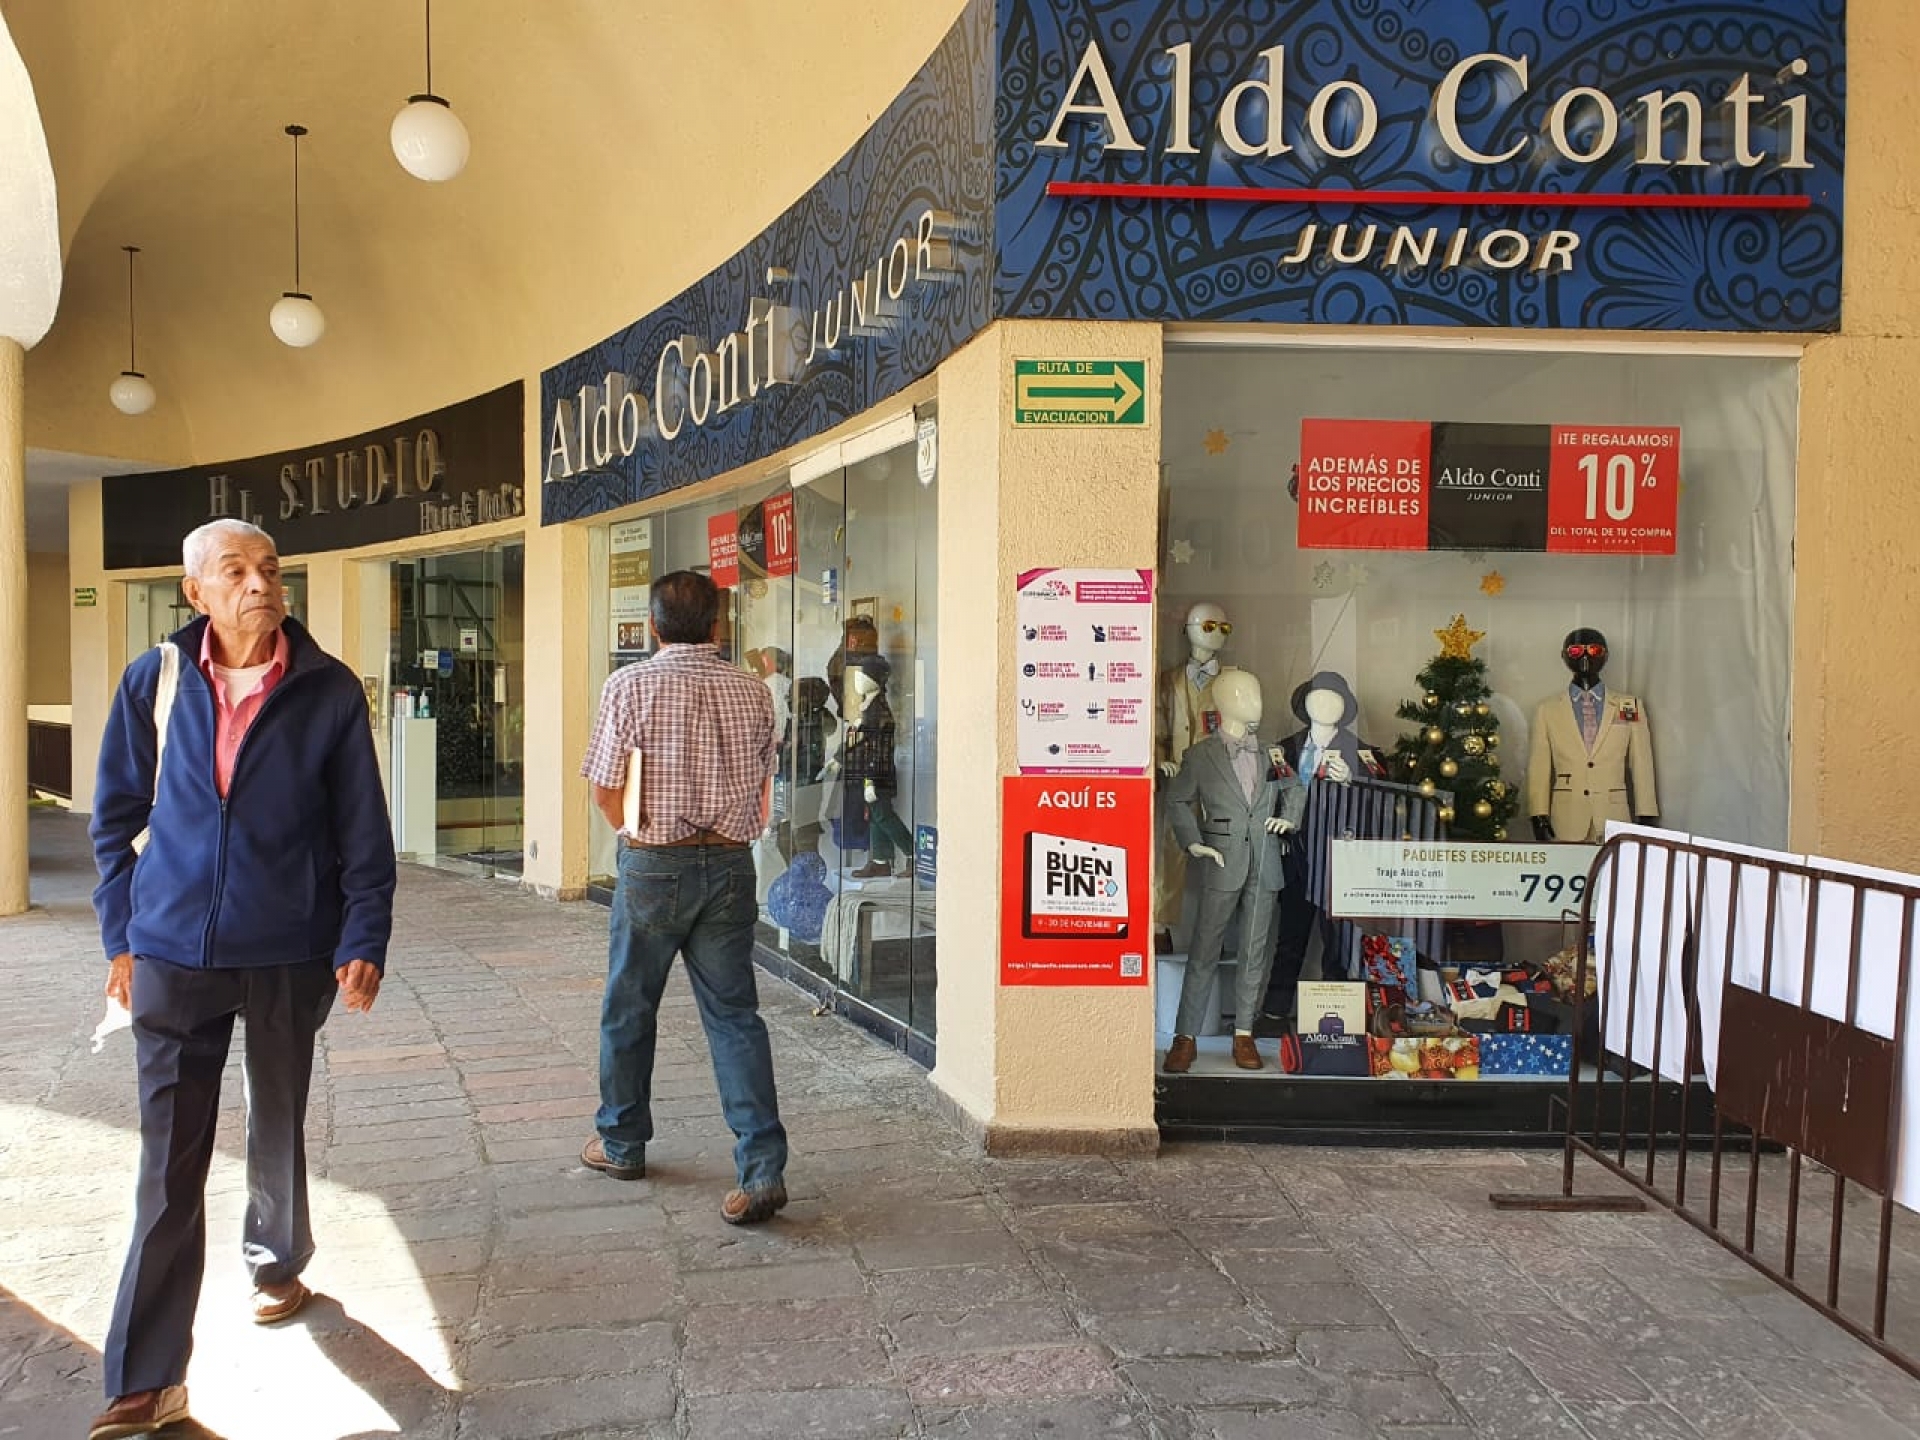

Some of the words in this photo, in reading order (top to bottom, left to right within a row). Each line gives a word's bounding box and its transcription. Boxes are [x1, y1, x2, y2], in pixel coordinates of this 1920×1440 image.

[1034, 39, 1379, 159] Aldo
[1434, 52, 1815, 171] Conti
[1282, 223, 1581, 272] JUNIOR
[805, 209, 938, 364] JUNIOR
[544, 373, 640, 484] Aldo
[655, 267, 780, 440] Conti
[1037, 362, 1070, 373] RUTA
[1076, 362, 1093, 373] DE
[1022, 411, 1108, 423] EVACUACION
[1582, 433, 1674, 447] REGALAMOS!
[279, 428, 438, 521] STUDIO
[1308, 453, 1389, 475] ADEMÁS
[1397, 459, 1421, 475] DE
[1308, 476, 1341, 492] LOS
[1346, 477, 1421, 494] PRECIOS
[1437, 467, 1485, 486] Aldo
[1490, 466, 1541, 488] Conti
[1577, 452, 1658, 522] 10%
[1307, 494, 1420, 516] INCREÍBLES
[1466, 493, 1513, 501] JUNIOR
[1550, 528, 1567, 536] DEL
[1571, 527, 1598, 537] TOTAL
[1602, 528, 1614, 537] DE
[1617, 527, 1627, 537] TU
[1630, 528, 1673, 538] COMPRA
[1037, 786, 1090, 809] AQUÍ
[1096, 791, 1117, 809] ES
[1046, 850, 1113, 877] BUEN
[1403, 848, 1467, 862] PAQUETES
[1471, 850, 1547, 865] ESPECIALES
[1377, 867, 1398, 878] Traje
[1400, 868, 1420, 877] Aldo
[1422, 868, 1444, 878] Conti
[1046, 872, 1096, 898] FIN
[1520, 873, 1587, 904] 799
